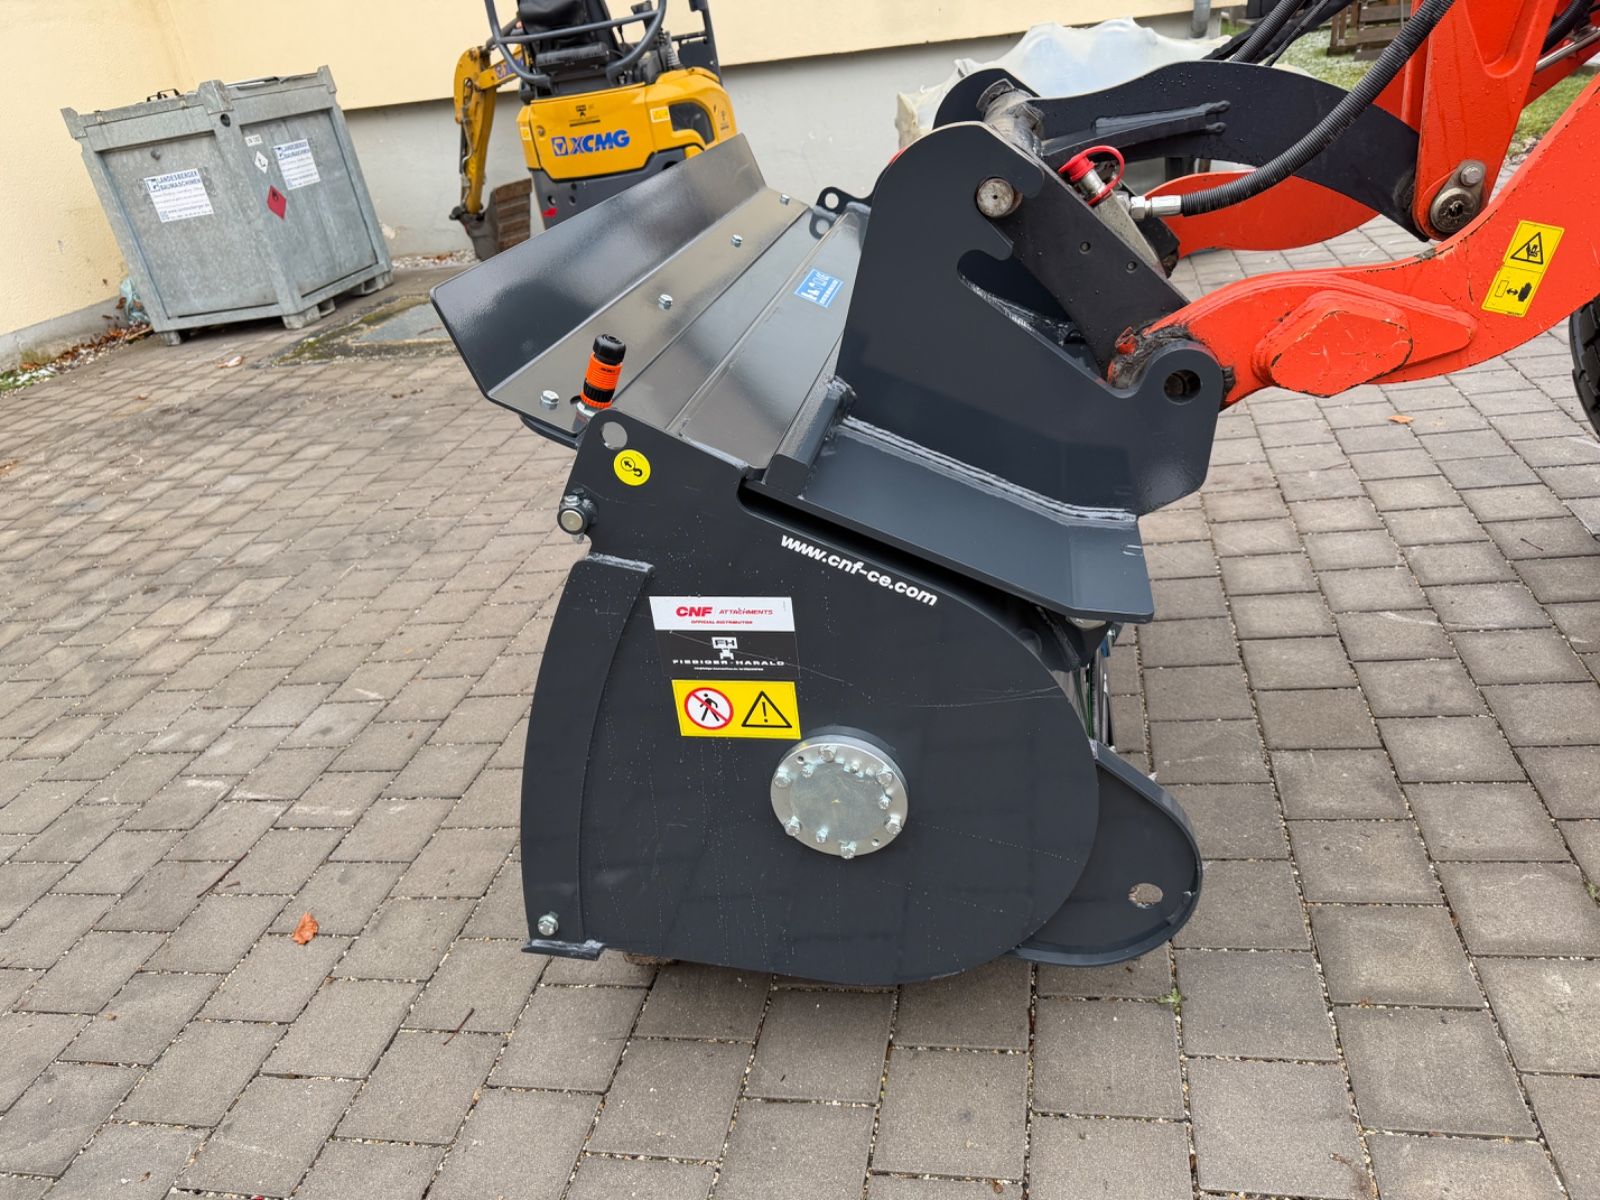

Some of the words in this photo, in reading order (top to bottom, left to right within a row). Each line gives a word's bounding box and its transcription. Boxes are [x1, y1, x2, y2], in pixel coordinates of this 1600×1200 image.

[570, 130, 630, 155] XCMG
[781, 534, 938, 606] www.cnf-ce.com
[676, 606, 713, 617] CNF
